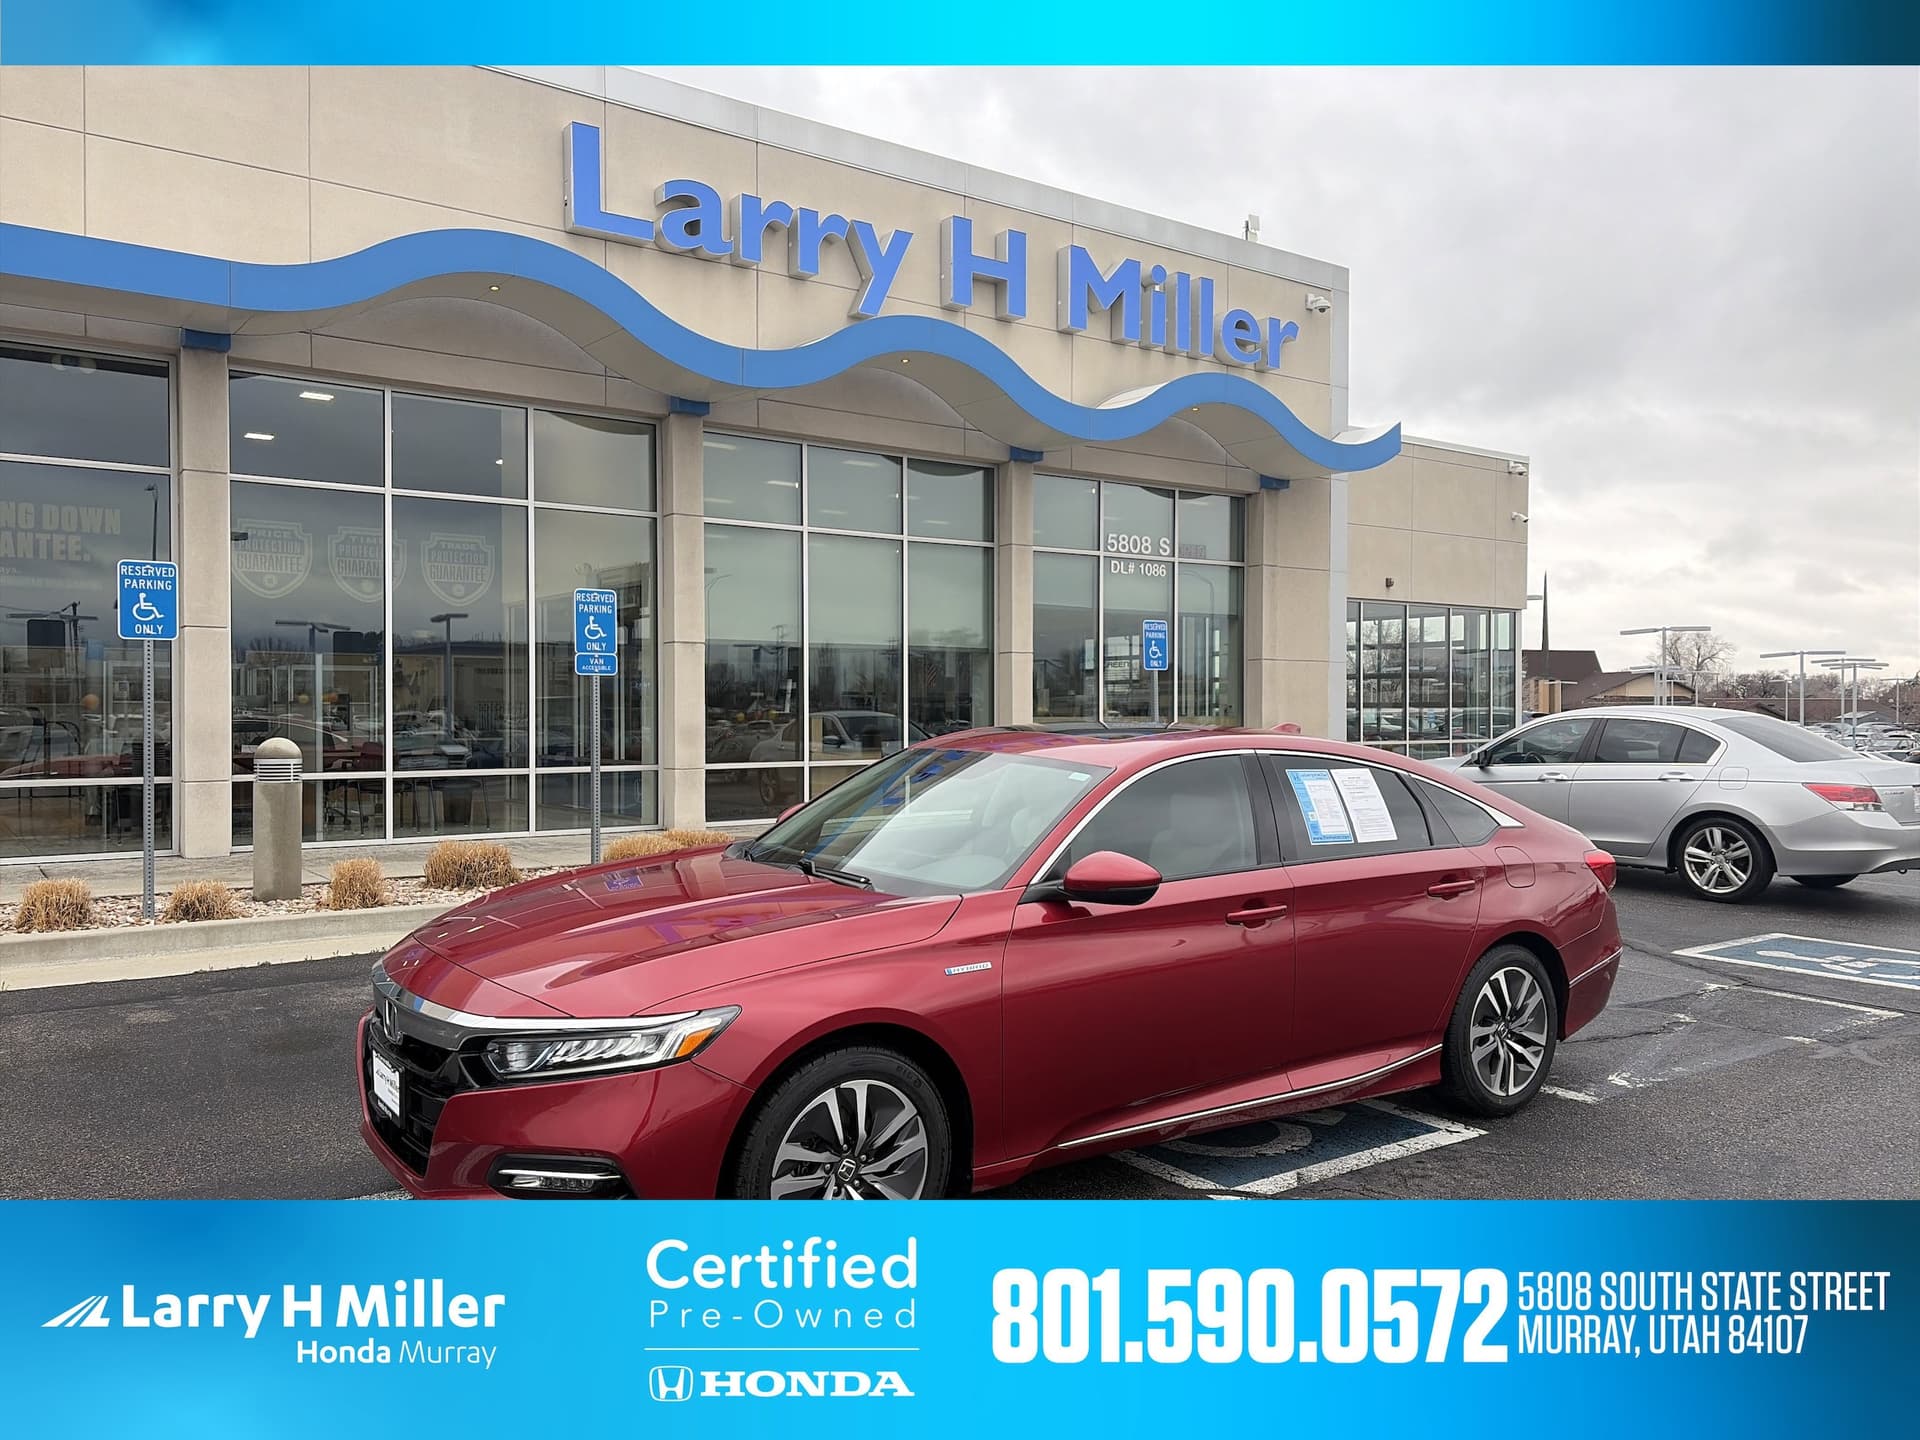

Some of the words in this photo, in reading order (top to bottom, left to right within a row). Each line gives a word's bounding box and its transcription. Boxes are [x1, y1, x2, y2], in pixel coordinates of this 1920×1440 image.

[563, 121, 914, 319] Larry
[941, 215, 1027, 320] H
[1058, 244, 1300, 371] Miller
[42, 504, 121, 535] DOWN
[249, 529, 291, 538] PRICE
[238, 540, 302, 554] PROTECTION
[441, 543, 477, 551] TRADE
[1107, 533, 1151, 554] 5808
[1159, 537, 1170, 556] S
[236, 554, 303, 573] GUARANTEE
[431, 551, 485, 564] PROTECTION
[121, 564, 175, 578] RESERVED
[430, 565, 486, 582] GUARANTEE
[1111, 560, 1135, 575] DL#
[1139, 563, 1167, 577] 1086
[124, 578, 172, 591] PARKING
[576, 593, 615, 602] RESERVED
[579, 604, 612, 614] PARKING
[134, 624, 164, 635] ONLY
[1144, 623, 1166, 631] RESERVED
[1145, 631, 1166, 639] PARKING
[586, 642, 607, 651] ONLY
